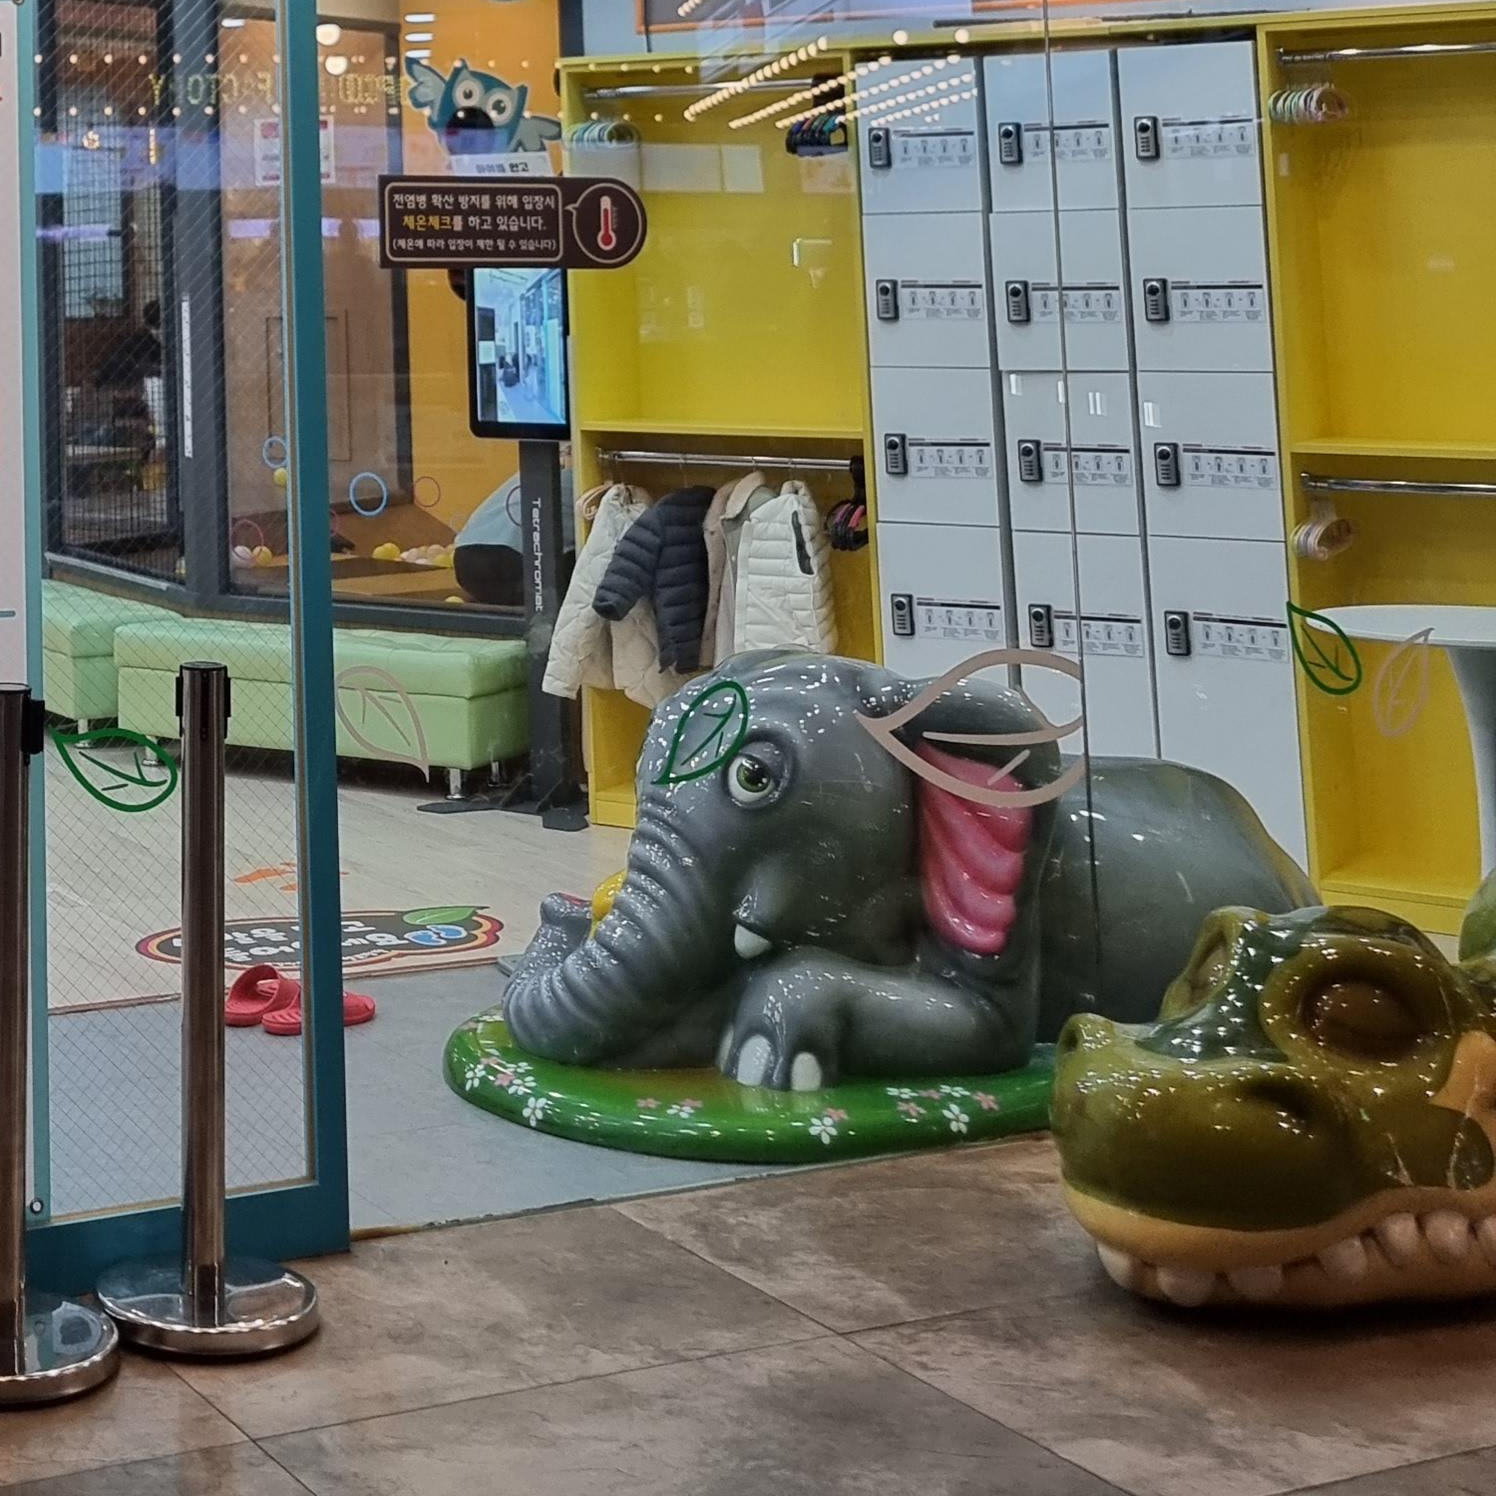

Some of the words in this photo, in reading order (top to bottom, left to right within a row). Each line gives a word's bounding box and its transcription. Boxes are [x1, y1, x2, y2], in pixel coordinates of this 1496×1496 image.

[392, 194, 427, 210] 전염병
[431, 194, 455, 210] 확산
[458, 194, 491, 210] 방지를
[495, 194, 519, 210] 위해
[522, 194, 555, 211] 입장시
[402, 214, 463, 231] 체온체크를
[468, 215, 493, 231] 하고
[496, 215, 547, 232] 있습니다.
